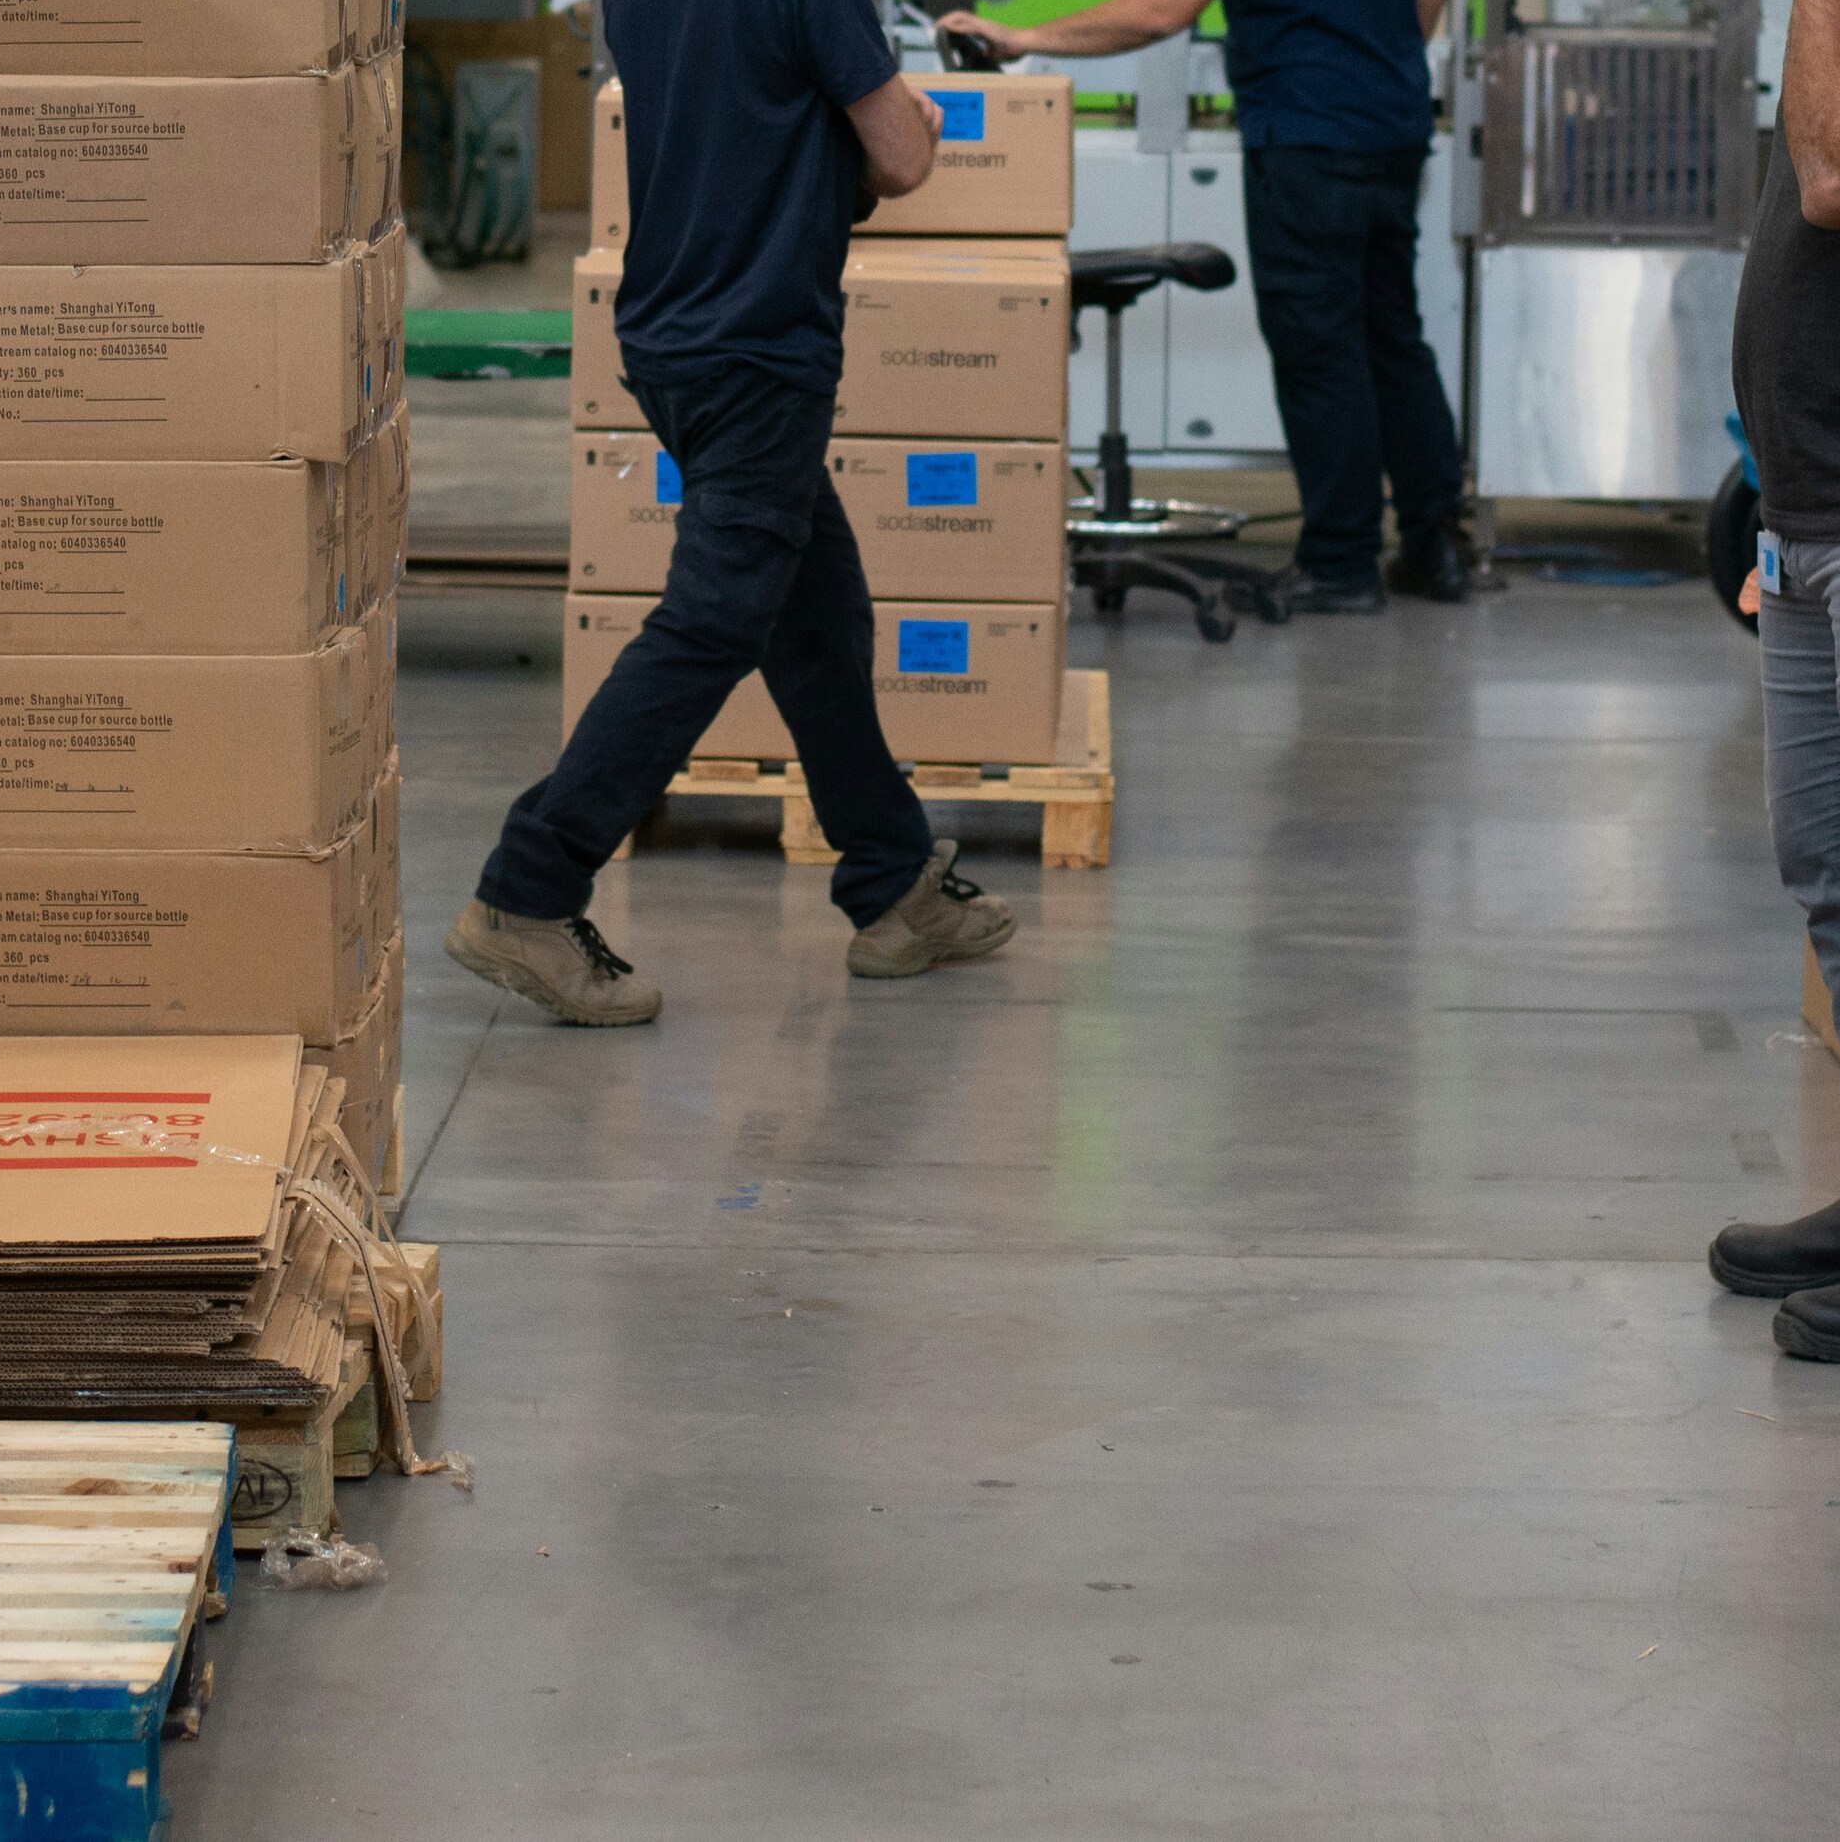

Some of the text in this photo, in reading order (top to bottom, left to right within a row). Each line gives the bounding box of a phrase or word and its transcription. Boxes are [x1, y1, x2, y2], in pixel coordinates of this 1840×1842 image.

[1, 10, 58, 22] date/time:
[0, 106, 36, 116] name:
[40, 103, 94, 117] Shanghai
[96, 102, 136, 115] YiTong
[0, 126, 36, 137] Metal:
[38, 124, 66, 136] Base
[68, 125, 90, 136] cup
[91, 122, 109, 133] for
[110, 124, 151, 134] source
[152, 122, 186, 134] bottle
[14, 146, 57, 160] catalog
[59, 148, 78, 158] no:
[81, 144, 148, 157] 6040336540
[25, 169, 46, 181] pcs
[8, 188, 65, 200] date/time:
[20, 304, 55, 315] name:
[60, 302, 114, 317] Shanghai
[116, 301, 156, 314] YiTong
[20, 324, 55, 336] Metal:
[58, 323, 86, 335] Base
[88, 324, 109, 336] cup
[111, 321, 128, 333] for
[130, 323, 170, 333] source
[172, 322, 206, 334] bottle
[33, 345, 77, 360] catalog
[78, 347, 98, 357] no:
[100, 343, 168, 356] 6040336540
[880, 347, 998, 369] sodastream
[17, 366, 38, 378] 360
[44, 367, 66, 380] pcs
[27, 387, 84, 399] date/time:
[20, 495, 74, 510] Shanghai
[75, 495, 115, 508] YiTong
[18, 515, 46, 528] Base
[47, 517, 69, 529] cup
[70, 514, 88, 526] for
[89, 516, 129, 527] source
[131, 515, 165, 528] bottle
[876, 511, 993, 534] sodastream
[38, 539, 57, 550] no:
[60, 536, 127, 550] 6040336540
[4, 560, 25, 572] pcs
[874, 675, 989, 696] sodastream
